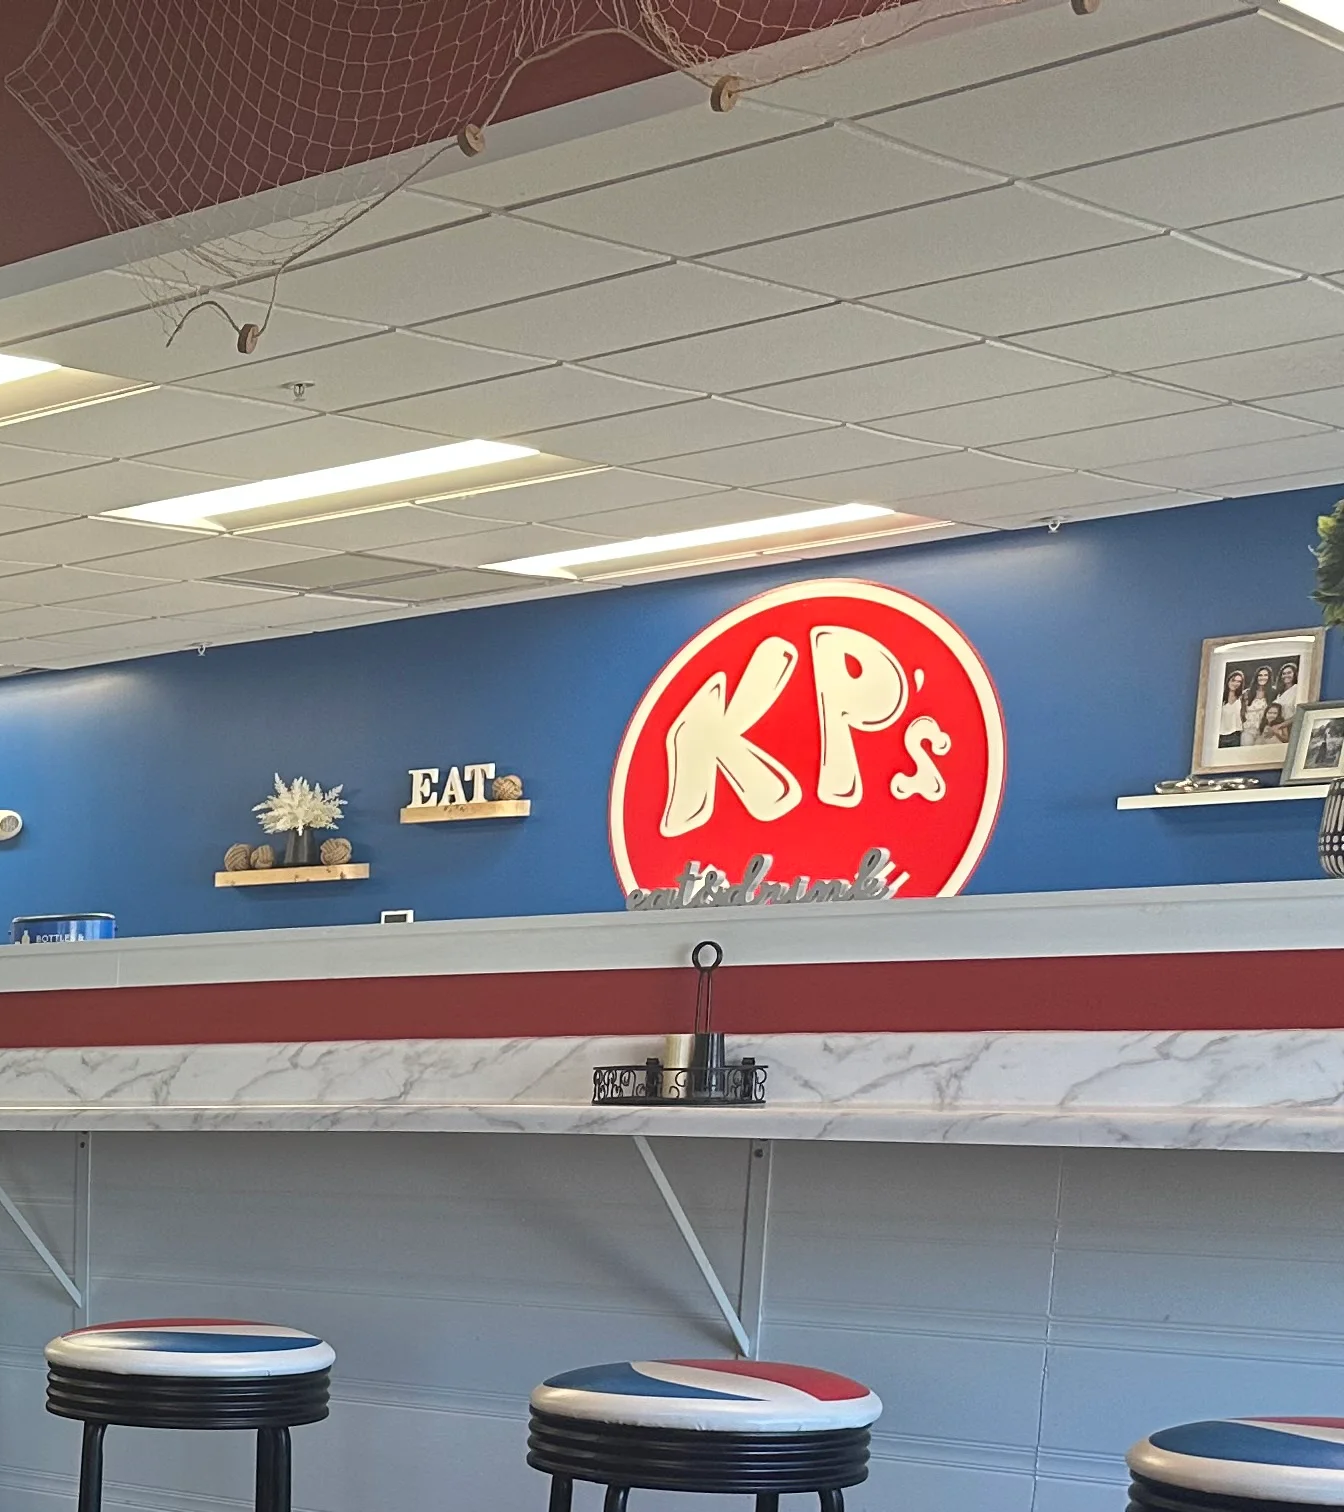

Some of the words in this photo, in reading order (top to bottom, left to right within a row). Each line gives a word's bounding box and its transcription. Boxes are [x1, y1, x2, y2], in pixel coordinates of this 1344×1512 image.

[660, 626, 952, 837] KP's
[407, 762, 496, 808] EAT
[36, 933, 76, 944] BOTTLES
